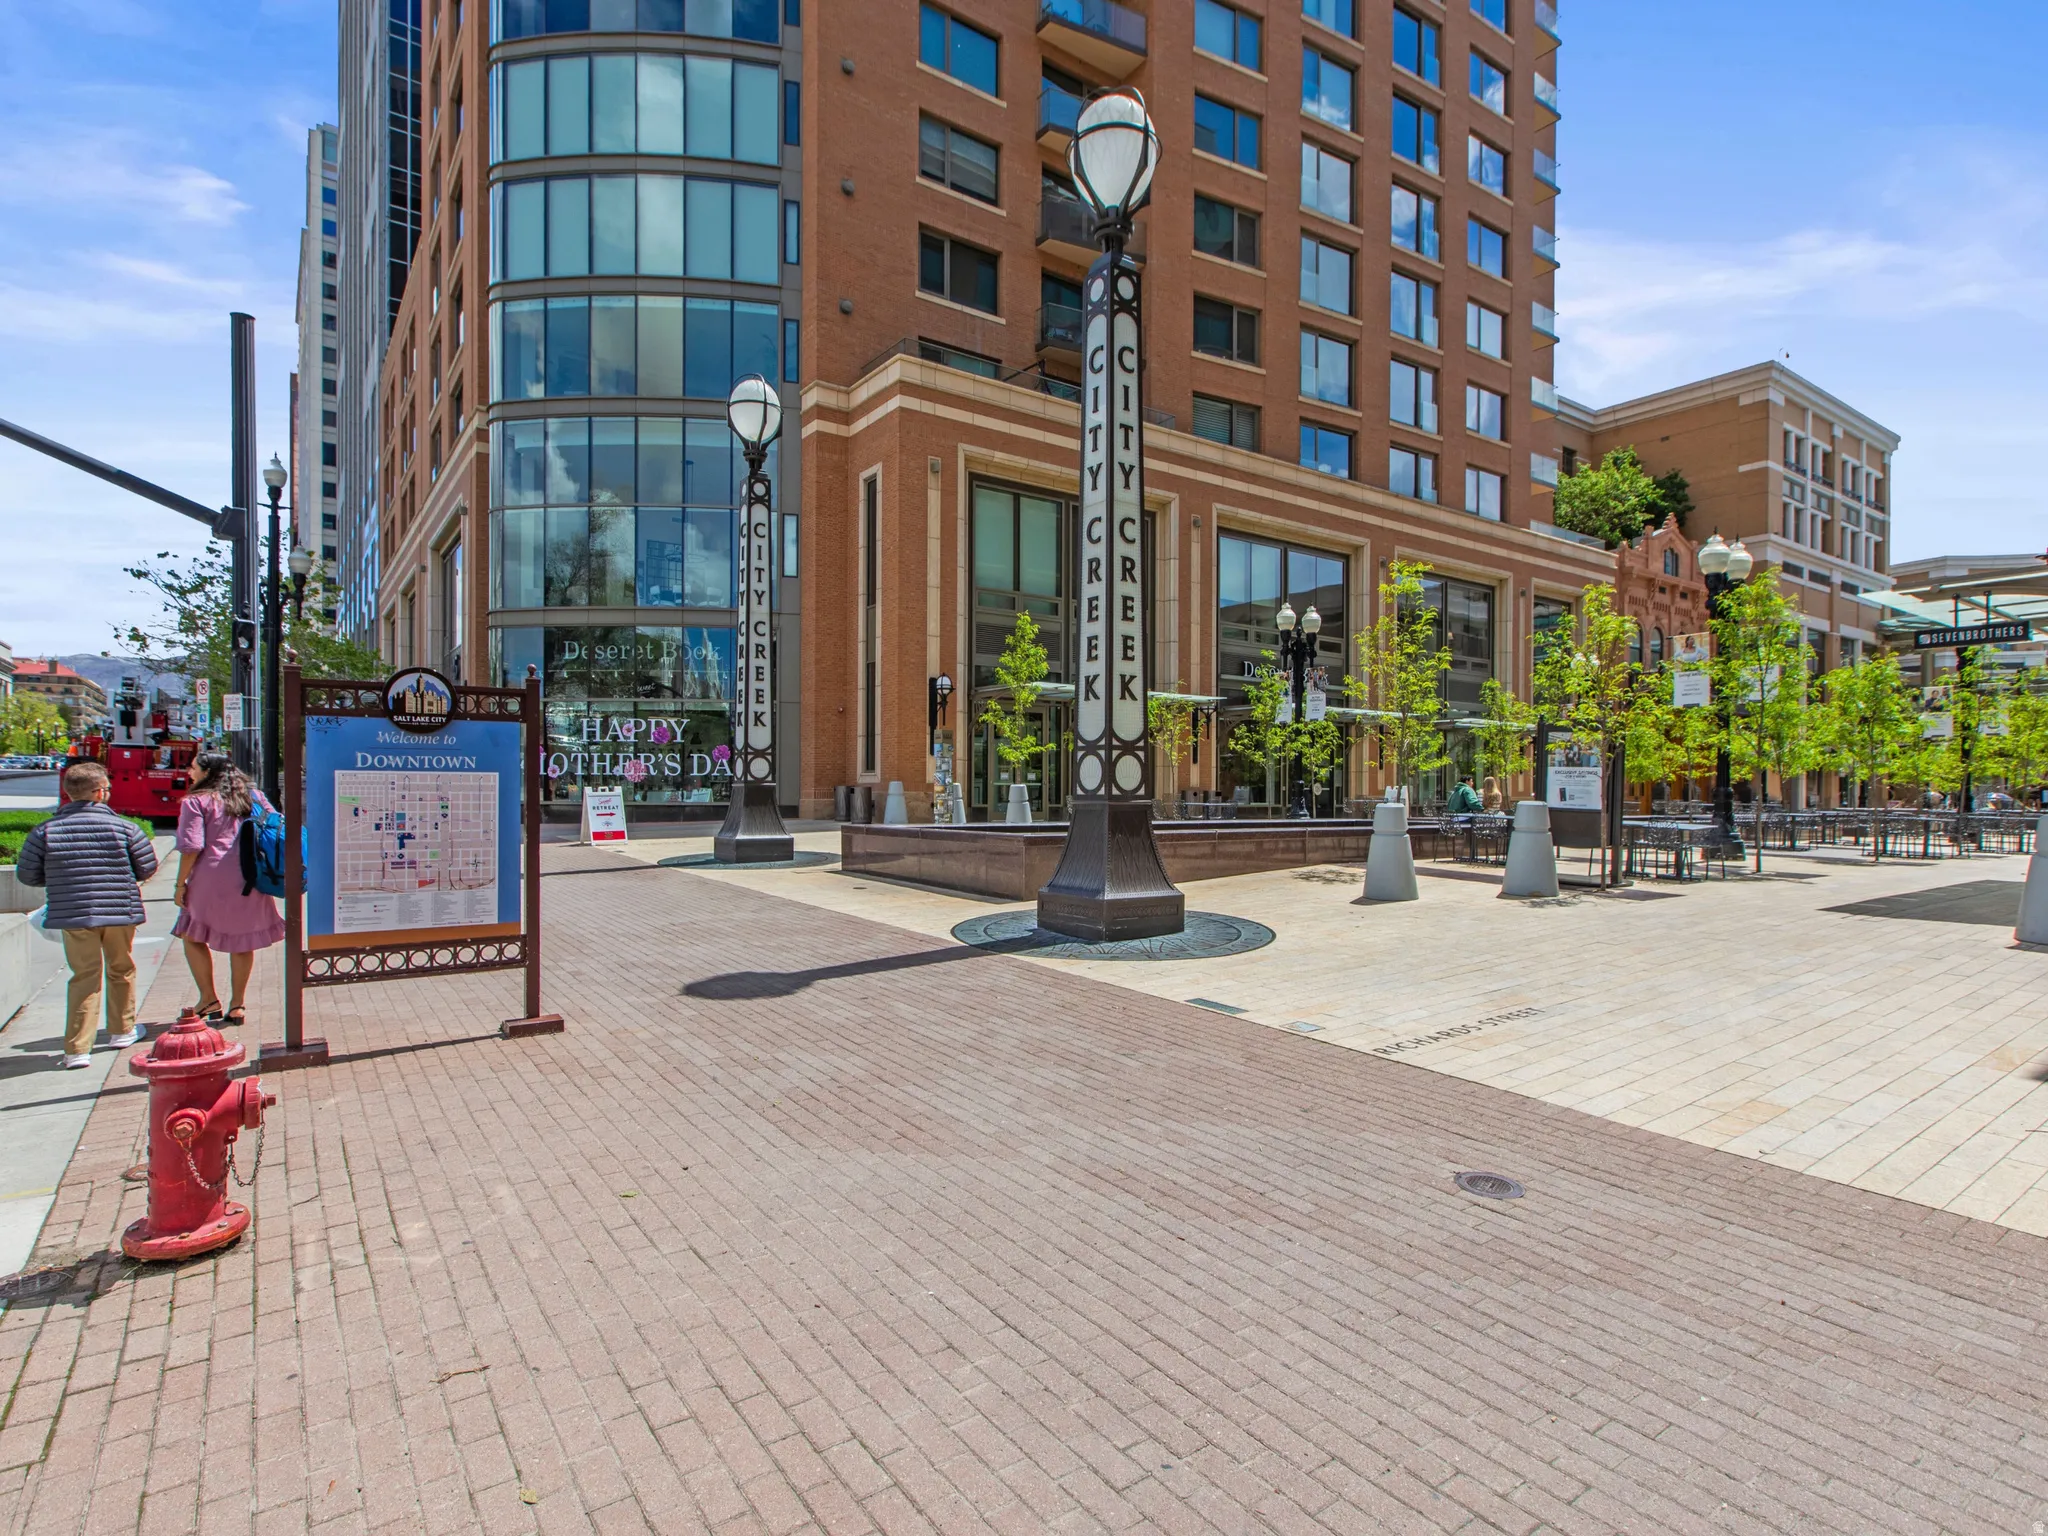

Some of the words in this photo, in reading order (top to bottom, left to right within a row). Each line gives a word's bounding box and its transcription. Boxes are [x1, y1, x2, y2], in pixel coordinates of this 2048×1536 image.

[1087, 345, 1104, 491] CITY
[1118, 345, 1136, 491] CITY
[753, 522, 766, 606] CITY
[1084, 516, 1102, 702] CREEK
[1119, 516, 1138, 702] CREEK
[660, 640, 723, 661] Book
[737, 620, 745, 727] CREEK
[753, 620, 767, 727] CREEK
[376, 731, 440, 745] Welcome
[443, 734, 457, 745] to
[540, 752, 682, 777] OTHER'S
[580, 718, 691, 743] HAPPY
[1372, 1023, 1481, 1055] RICHARDS
[1477, 1007, 1546, 1028] STREET
